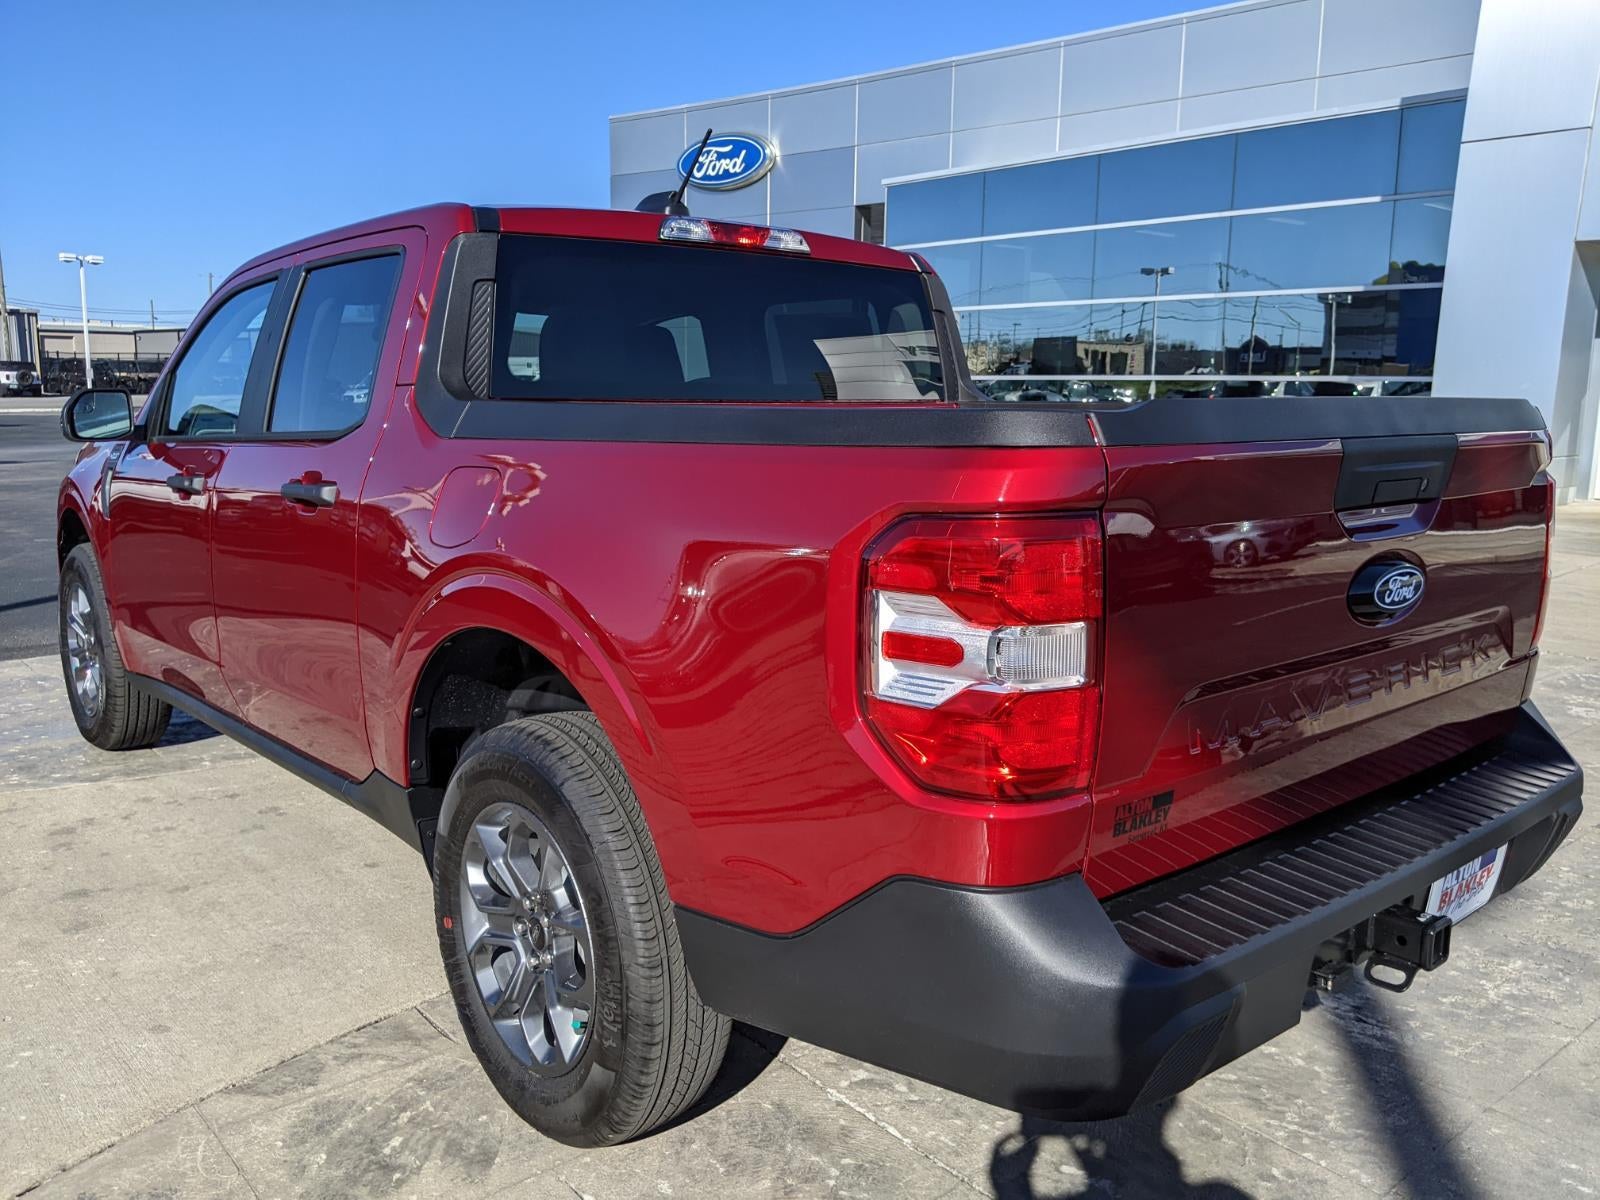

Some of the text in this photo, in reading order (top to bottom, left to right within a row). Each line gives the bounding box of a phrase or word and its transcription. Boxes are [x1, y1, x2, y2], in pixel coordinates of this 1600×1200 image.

[693, 145, 746, 178] Ford
[1385, 575, 1416, 603] Ford
[1187, 633, 1492, 755] MAVERICK
[1113, 806, 1170, 837] BLAKLEY
[1437, 864, 1494, 912] BLAKLEY
